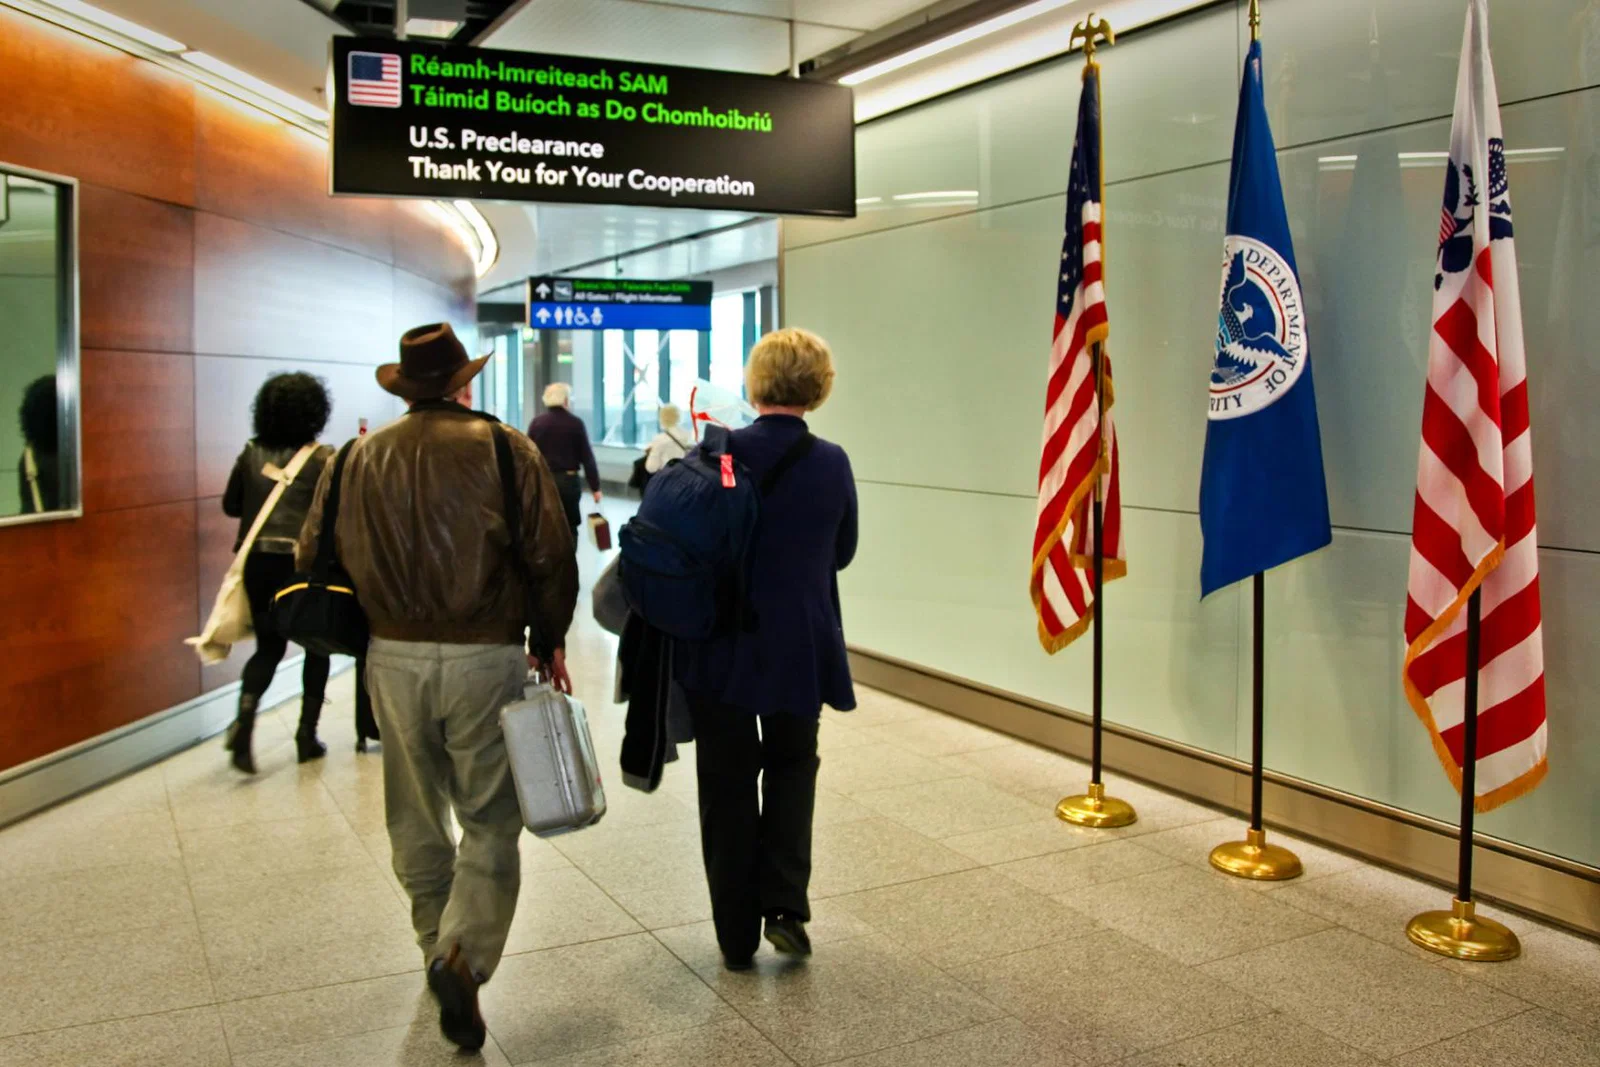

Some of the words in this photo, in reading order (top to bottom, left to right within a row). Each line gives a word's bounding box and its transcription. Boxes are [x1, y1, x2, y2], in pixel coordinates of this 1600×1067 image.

[410, 53, 614, 91] Réamh-Imreiteach
[619, 72, 668, 95] SAM
[409, 84, 490, 110] Táimid
[496, 91, 571, 116] Buíoch
[576, 102, 600, 119] as
[605, 100, 637, 121] Do
[641, 103, 773, 132] Chomhoibriú
[409, 125, 455, 150] U.S.
[461, 129, 604, 159] Preclearance
[408, 156, 482, 182] Thank
[485, 160, 531, 184] You
[535, 163, 568, 186] for
[572, 166, 624, 189] Your
[627, 168, 755, 197] Cooperation
[1246, 248, 1301, 371] DEPARTMENT
[1265, 371, 1287, 394] OF
